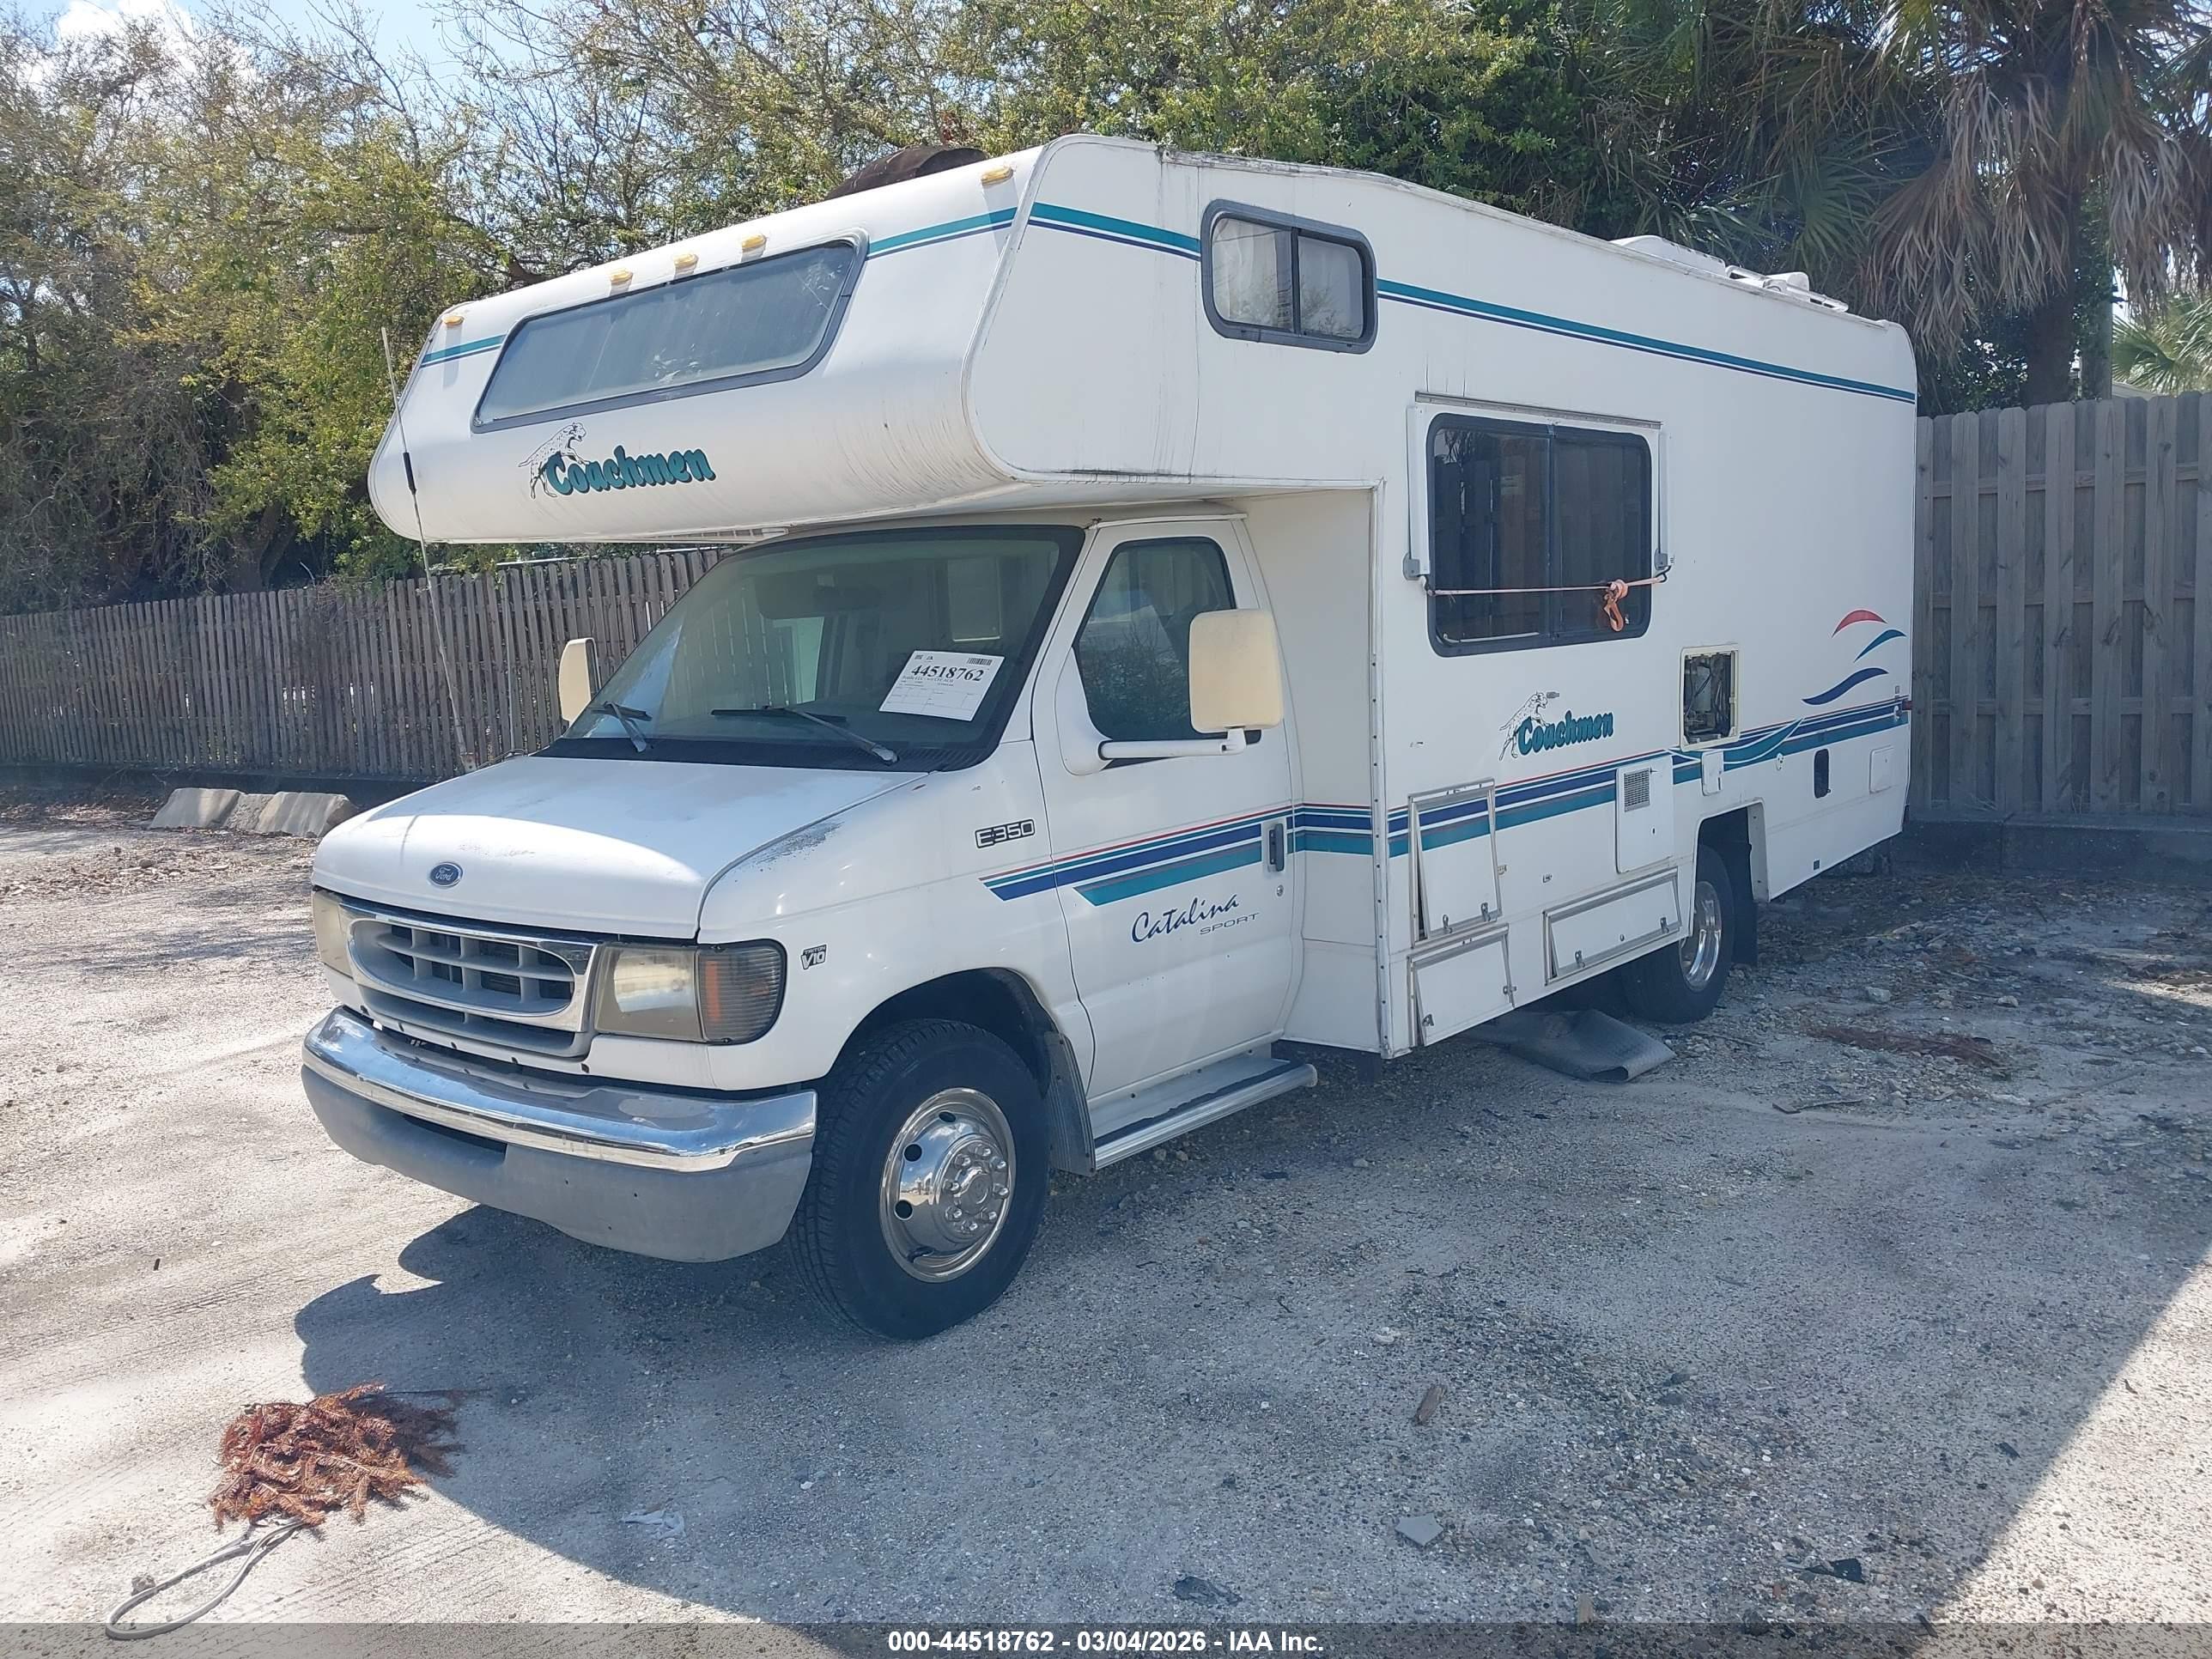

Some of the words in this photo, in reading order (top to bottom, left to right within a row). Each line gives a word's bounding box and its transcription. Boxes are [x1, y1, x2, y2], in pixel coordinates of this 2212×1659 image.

[542, 445, 717, 496] Coachmen
[911, 665, 984, 682] 44518762
[1516, 710, 1614, 756] Coachmen
[1132, 894, 1239, 943] Catalina
[1200, 912, 1260, 935] SPORT
[801, 951, 826, 969] V10
